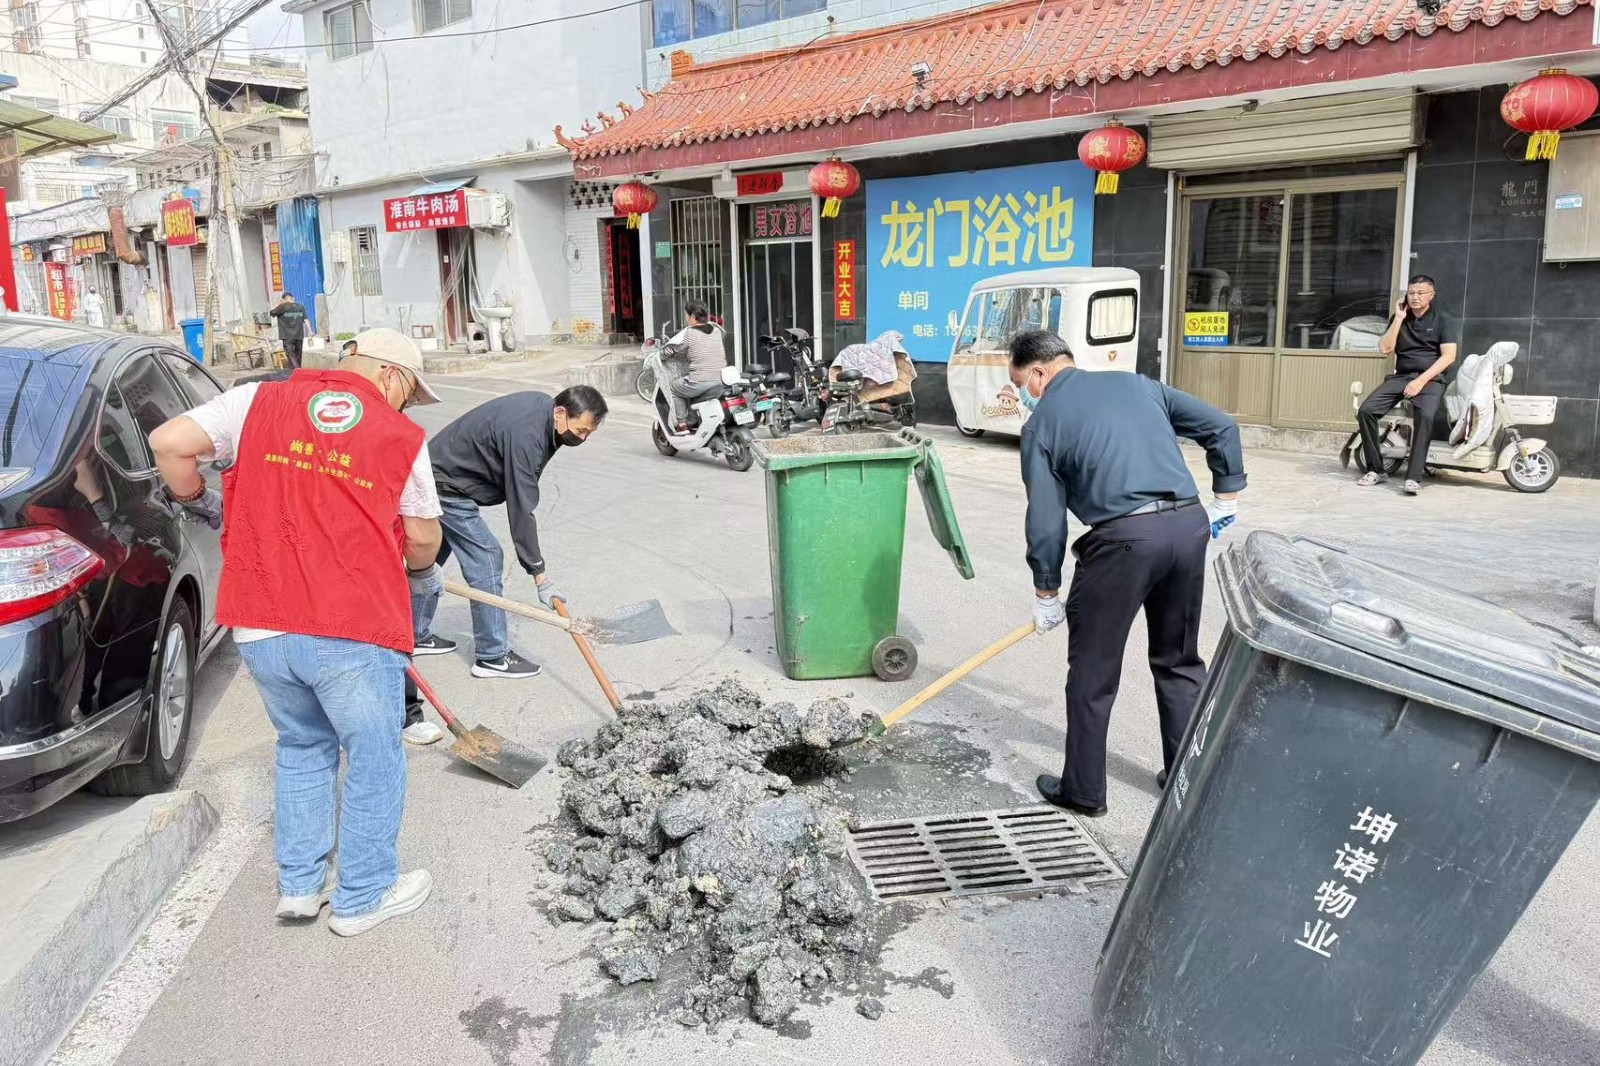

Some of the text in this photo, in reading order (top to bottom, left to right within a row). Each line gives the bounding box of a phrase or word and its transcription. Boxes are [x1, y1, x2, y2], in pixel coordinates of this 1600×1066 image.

[1500, 181, 1539, 197] 龍門
[390, 194, 459, 219] 淮南牛肉汤
[755, 203, 812, 237] 男女浴池
[880, 186, 1075, 268] 龙门浴池
[838, 242, 852, 317] 开业大吉
[897, 291, 929, 310] 单间
[1294, 805, 1398, 958] 坤诺物业
